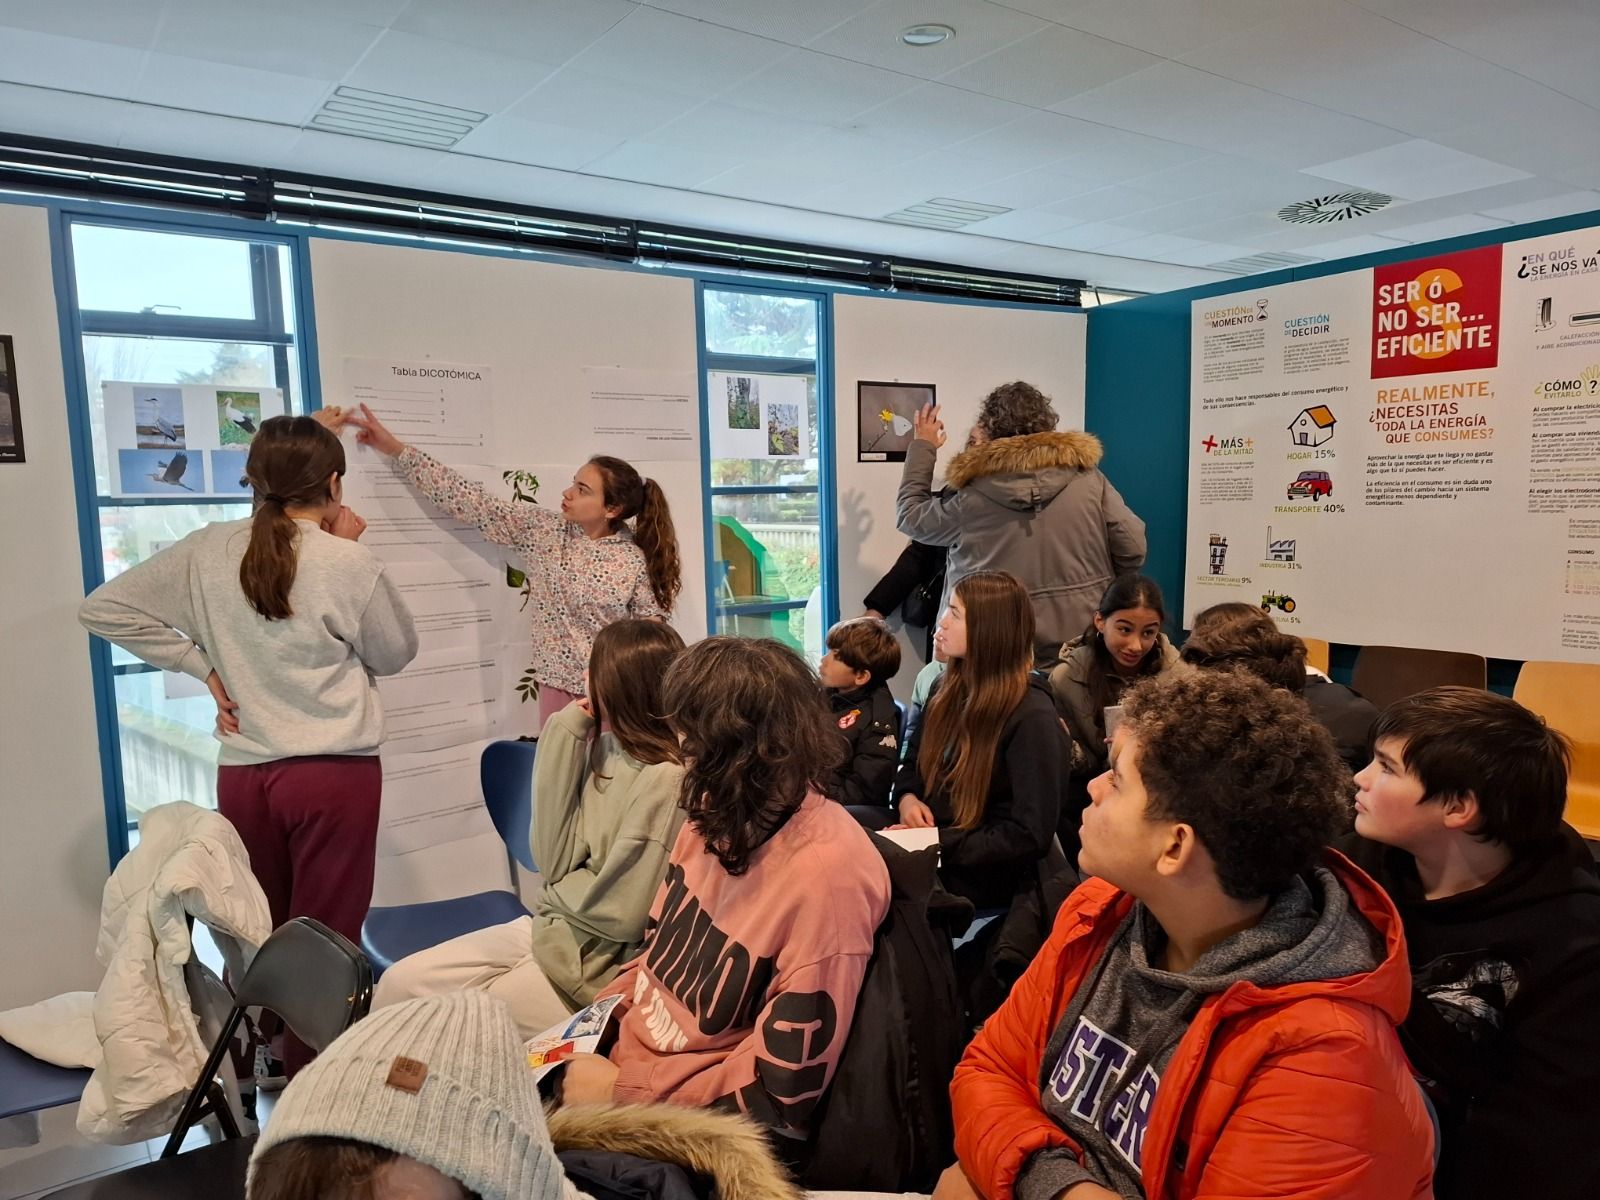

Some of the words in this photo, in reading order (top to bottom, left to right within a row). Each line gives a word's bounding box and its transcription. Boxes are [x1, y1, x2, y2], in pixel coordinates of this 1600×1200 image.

[1548, 246, 1576, 260] QUÉ
[1531, 264, 1547, 276] SE
[1551, 260, 1578, 272] NOS
[1582, 256, 1598, 268] VA
[1378, 280, 1420, 306] SER
[1429, 275, 1442, 299] Ó
[1204, 306, 1246, 320] CUESTIÓN
[1378, 309, 1408, 333] NO
[1416, 302, 1484, 328] SER...
[1211, 315, 1254, 328] MOMENTO
[1284, 314, 1330, 328] CUESTIÓN
[1292, 325, 1330, 338] DECIDIR
[1377, 324, 1492, 359] EFICIENTE
[1556, 340, 1600, 348] ACONDICIONAD
[392, 366, 417, 376] Tabla
[420, 368, 482, 380] DICOTÓMICA
[1377, 381, 1495, 404] REALMENTE,
[1544, 380, 1582, 392] CÓMO
[1544, 391, 1582, 399] EVITARLO
[1369, 402, 1459, 422] ¿NECESITAS
[1376, 421, 1406, 432] TODA
[1410, 420, 1424, 430] LA
[1430, 414, 1487, 428] ENERGÍA
[1220, 436, 1244, 448] MÁS
[1386, 433, 1410, 444] QUE
[1414, 428, 1494, 442] CONSUMES?
[1287, 452, 1312, 460] HOGAR
[1315, 450, 1336, 459] 15%
[1274, 505, 1321, 513] TRANSPORTE
[1323, 504, 1345, 513] 40%
